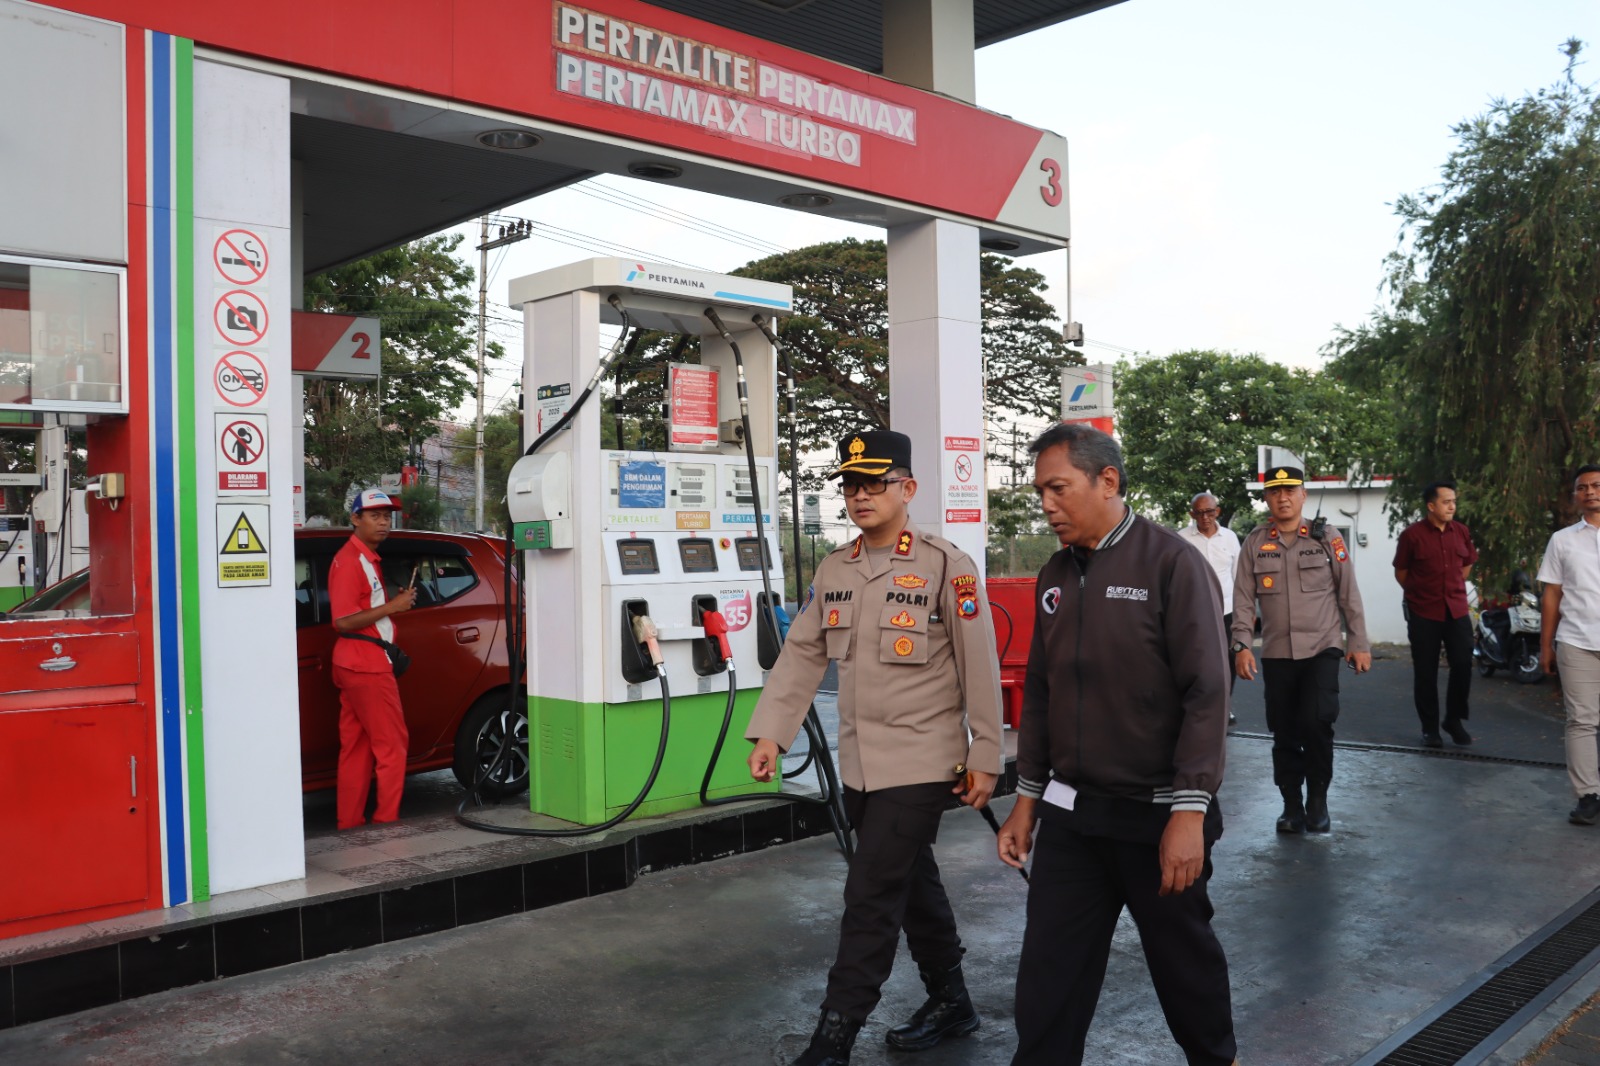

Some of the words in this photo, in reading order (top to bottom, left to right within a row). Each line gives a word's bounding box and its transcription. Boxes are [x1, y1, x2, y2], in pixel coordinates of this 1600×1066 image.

[561, 7, 750, 92] PERTALITE
[759, 65, 915, 141] PERTAMAX
[560, 53, 750, 137] PERTAMAX
[760, 108, 858, 164] TURBO
[1040, 157, 1063, 207] 3
[648, 273, 706, 290] PERTAMINA
[351, 331, 371, 360] 2
[222, 374, 240, 383] ON
[1068, 404, 1098, 412] PERTAMINA
[227, 473, 259, 481] DILARANG
[640, 473, 662, 482] DALAM
[610, 514, 660, 524] PERTALITE
[725, 514, 768, 523] PERTAMX
[1299, 549, 1324, 557] POLRI
[824, 590, 853, 604] PANJI
[1106, 585, 1149, 597] RUBYTECH
[885, 591, 929, 607] POLRI
[725, 605, 749, 627] 35
